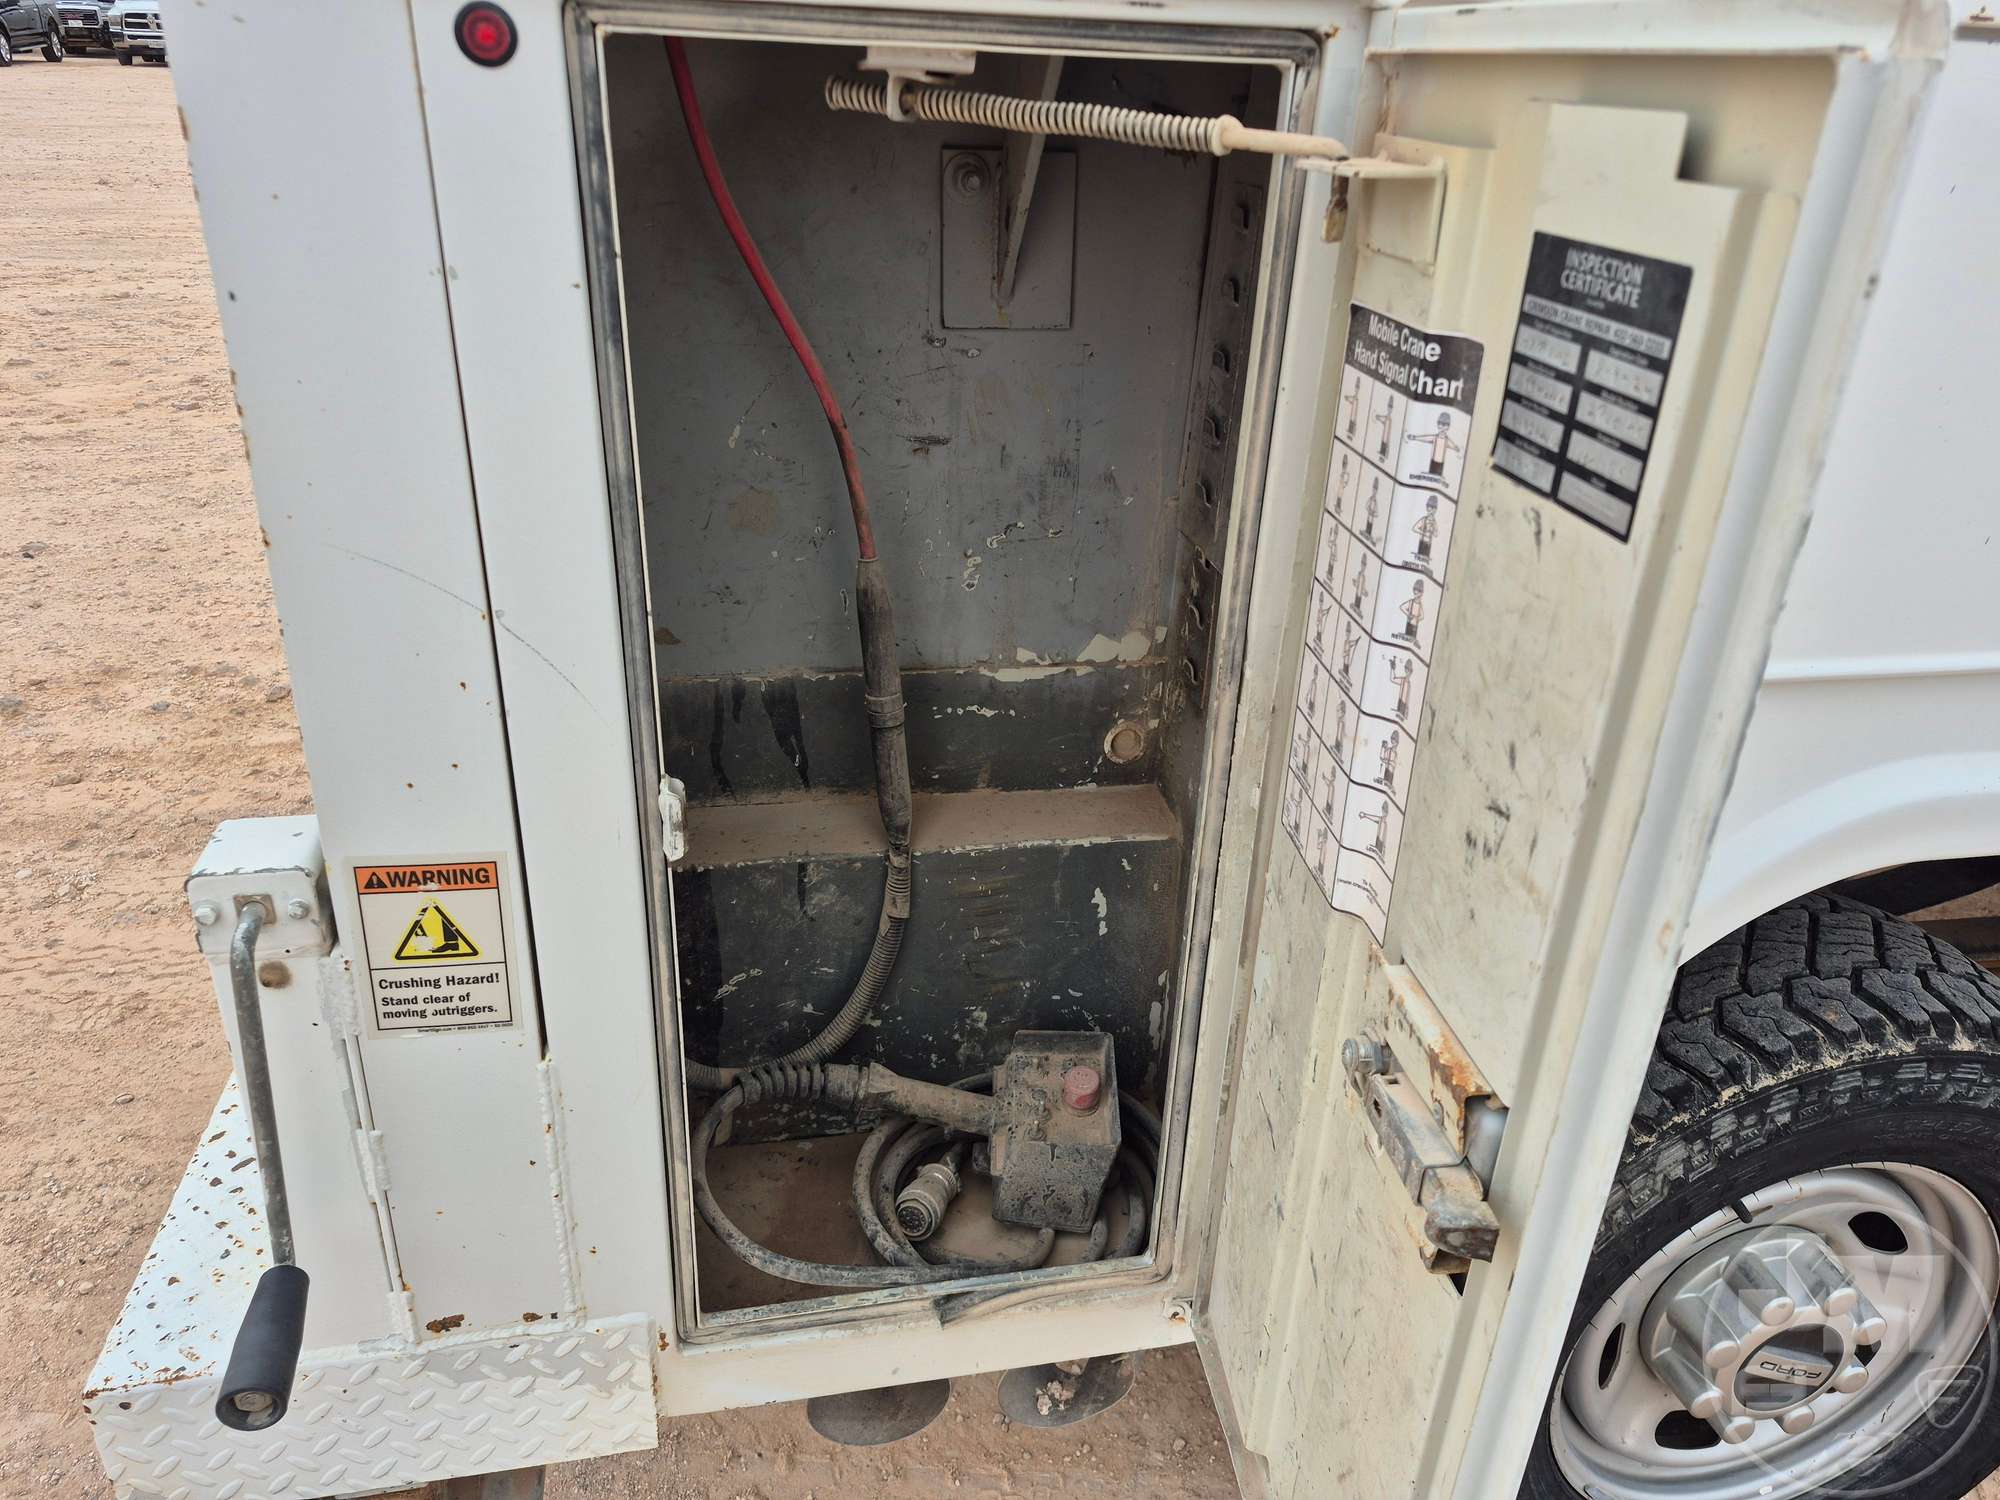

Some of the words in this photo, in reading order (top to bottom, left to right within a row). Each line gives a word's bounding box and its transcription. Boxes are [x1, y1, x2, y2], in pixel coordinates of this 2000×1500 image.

[1565, 247, 1645, 285] INSPECTION
[1560, 269, 1642, 309] CERTIFICATE
[1368, 314, 1399, 347] Mobile
[1400, 327, 1442, 362] Crane
[1354, 340, 1378, 370] Hand
[1378, 353, 1409, 387] Signal
[1409, 367, 1465, 401] Chart
[386, 868, 490, 888] WARNING
[378, 977, 441, 990] Crushing
[446, 972, 500, 987] Hazard!
[381, 996, 418, 1007] Stand
[422, 993, 454, 1005] clear
[458, 992, 471, 1002] of
[383, 1007, 427, 1020] moving
[431, 1004, 498, 1018] outriggers.
[1760, 1360, 1822, 1380] FORD
